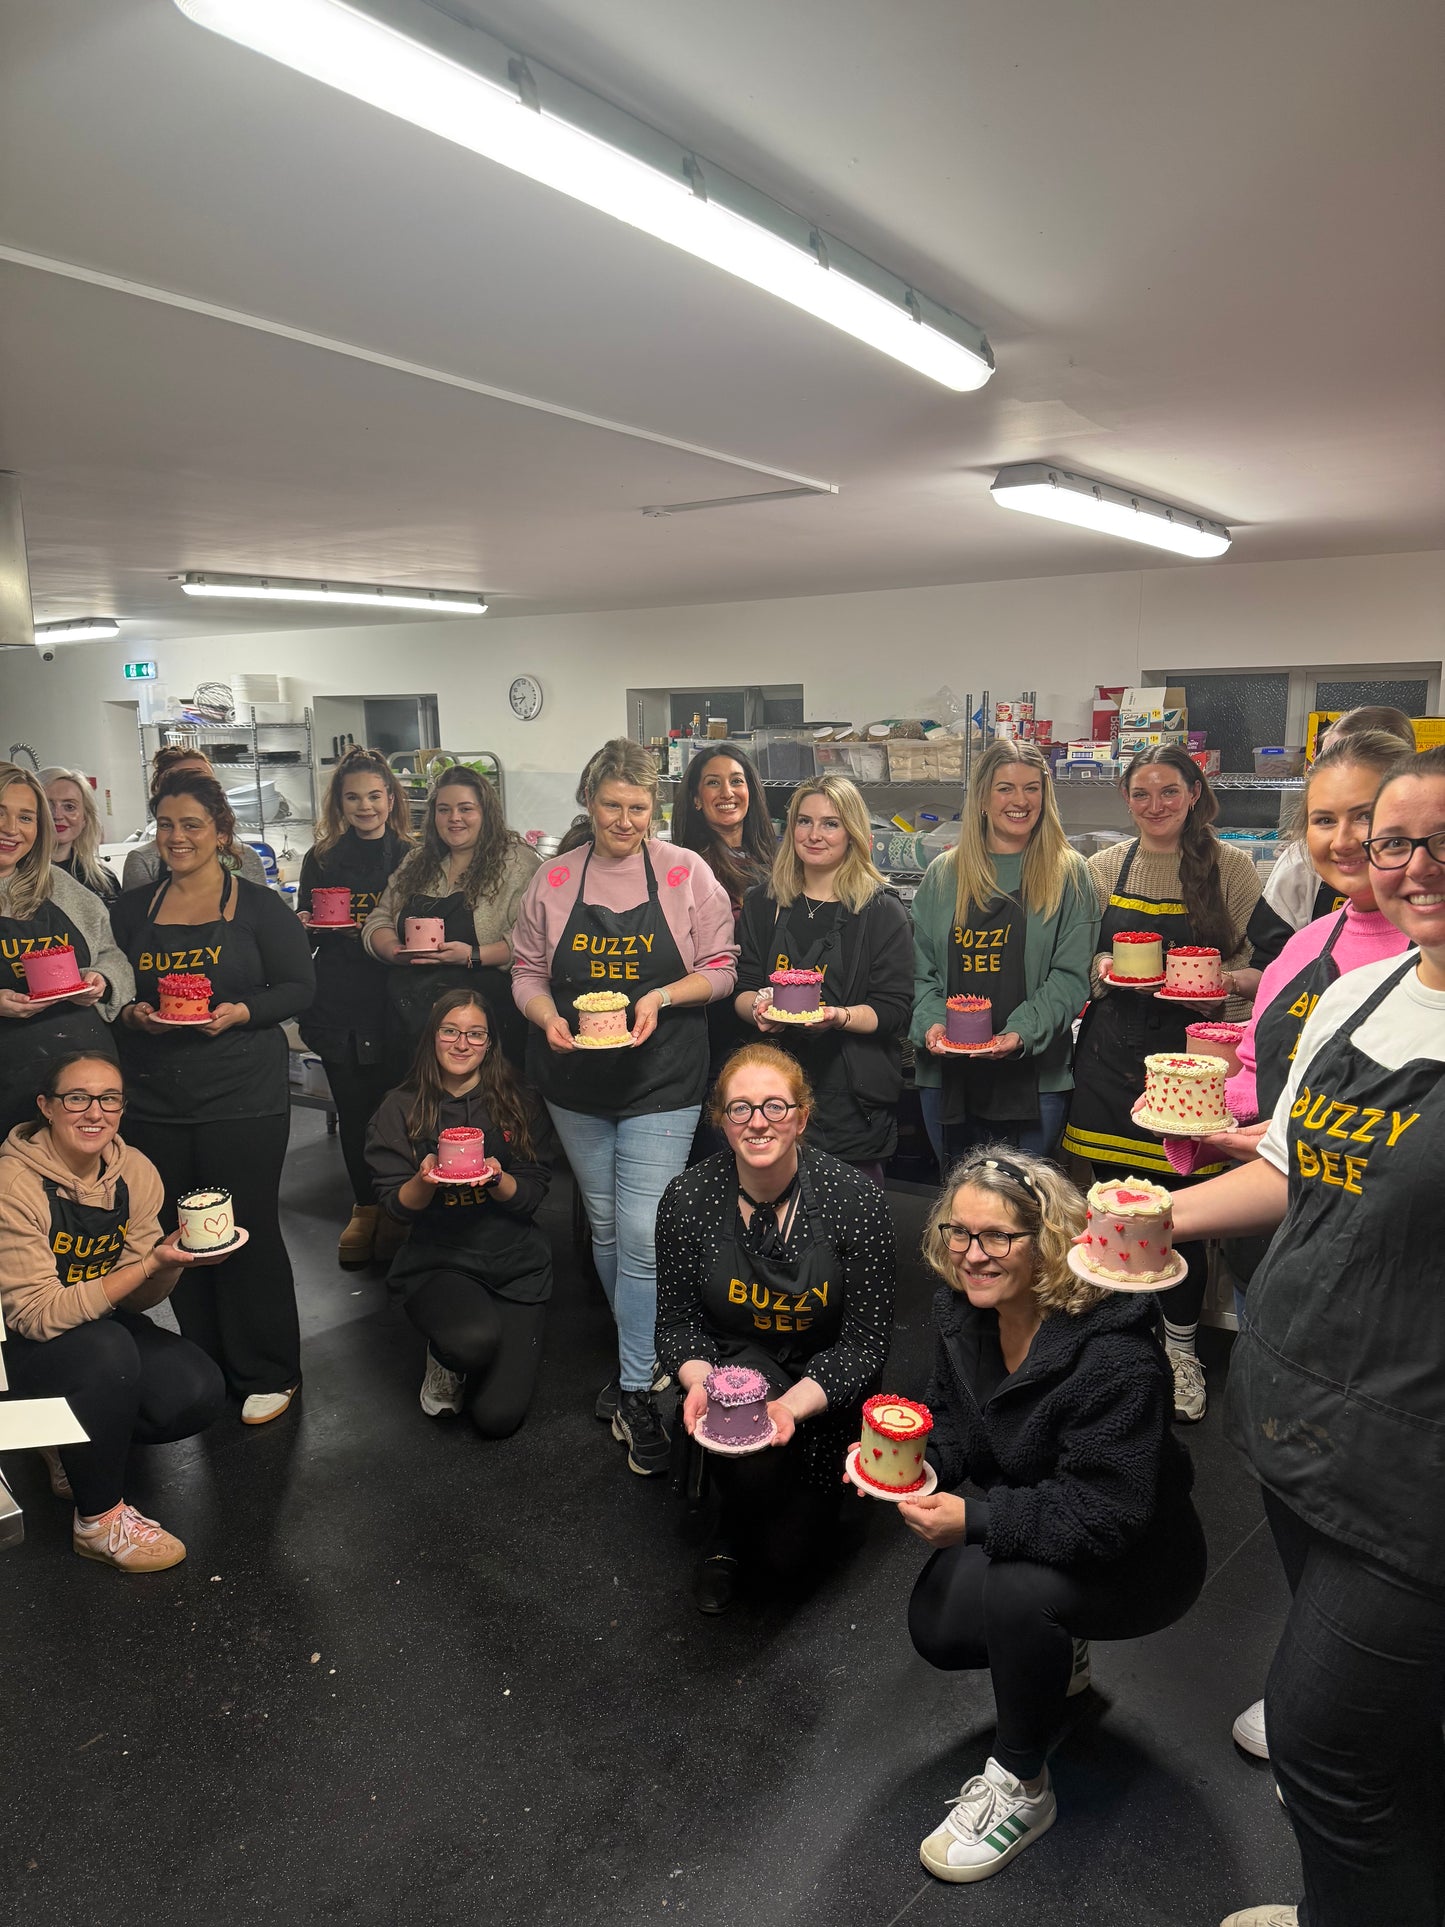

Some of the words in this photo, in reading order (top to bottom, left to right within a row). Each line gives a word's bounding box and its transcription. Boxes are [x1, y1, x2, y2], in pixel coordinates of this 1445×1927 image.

[1110, 716, 1120, 741] Bisco
[1, 933, 69, 959] UZZY
[572, 933, 654, 956] BUZZY
[139, 945, 222, 971] BUZZY
[590, 960, 640, 979] BEE
[1291, 1086, 1421, 1147] BUZZY
[1297, 1139, 1369, 1196] BEE
[728, 1278, 829, 1312] BUZZY
